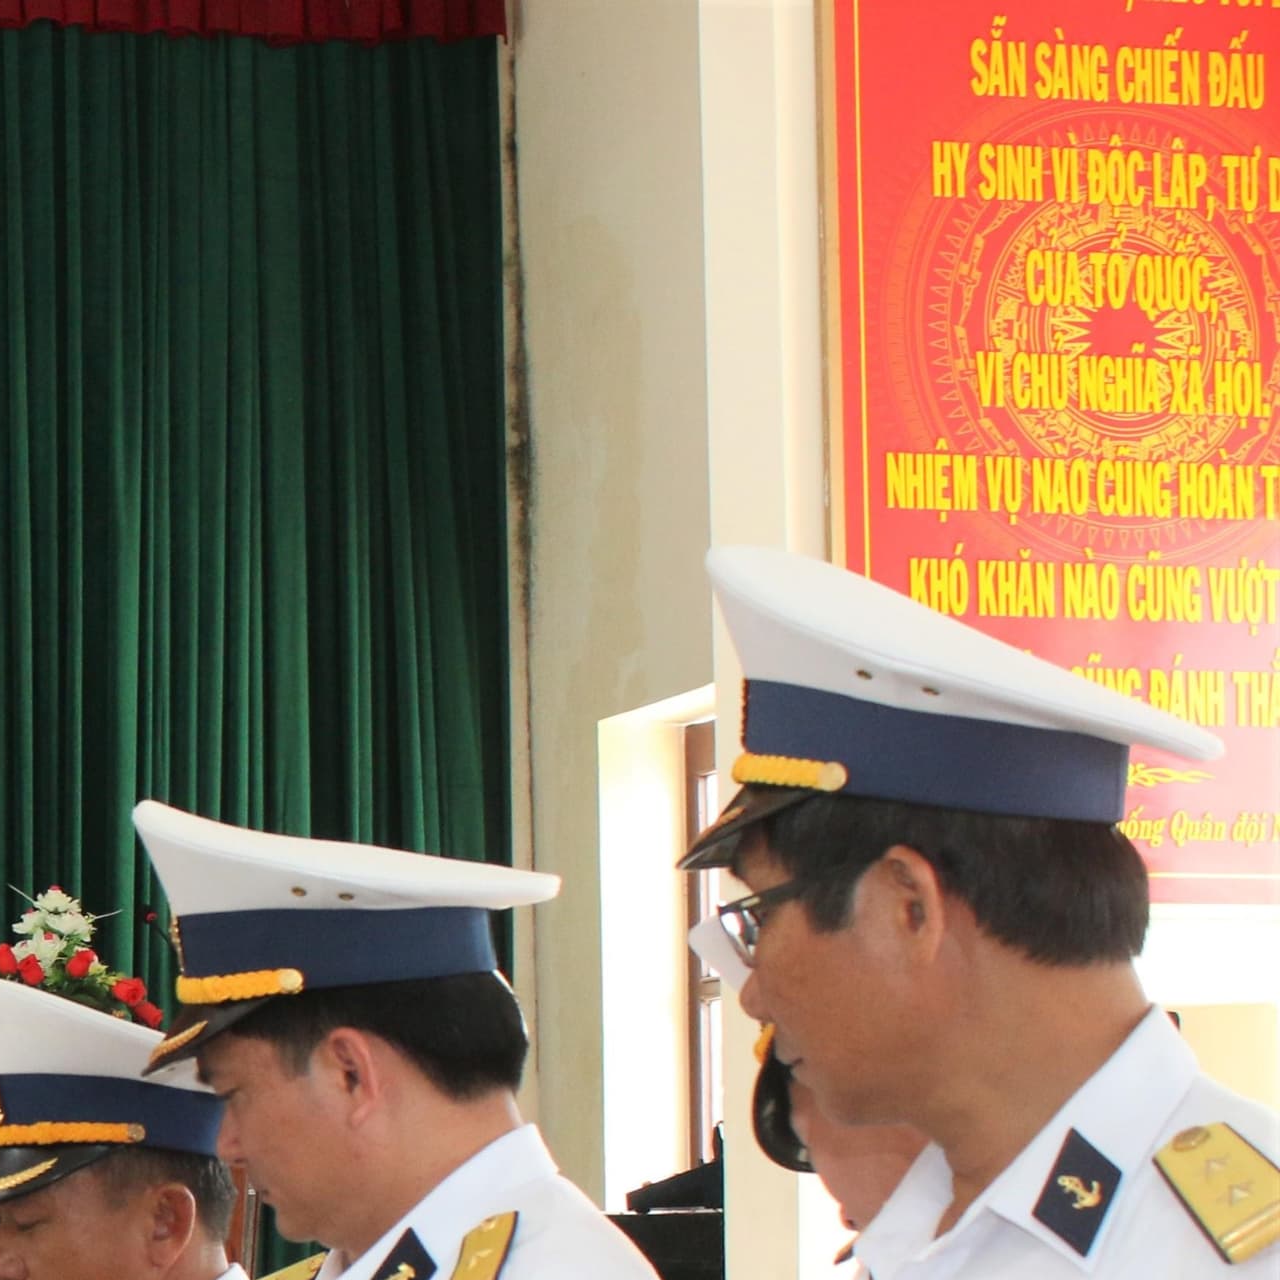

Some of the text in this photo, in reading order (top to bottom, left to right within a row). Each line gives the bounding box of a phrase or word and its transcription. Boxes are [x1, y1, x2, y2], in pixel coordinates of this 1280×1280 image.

[970, 15, 1265, 110] SẴN SÀNG CHIẾN ĐẤU
[932, 141, 970, 198] HY
[979, 143, 1043, 202] SINH
[1051, 132, 1084, 204] VÌ
[1088, 134, 1145, 217] ĐỘC
[1153, 137, 1215, 222] LẬP,
[1221, 145, 1261, 224] TỰ
[1026, 223, 1219, 324] CỦA TỔ QUỐC,
[976, 337, 1004, 407] VÌ
[1013, 331, 1068, 411] CHỦ
[1078, 343, 1161, 414] NGHĨA
[1169, 344, 1204, 416] XÃ
[886, 438, 1280, 525] NHIỆM VỤ NÀO CŨNG HOÀN T
[909, 542, 1280, 636] KHÓ KHĂN NÀO CŨNG VƯỢT
[1150, 654, 1225, 727] ĐÁNH
[1170, 810, 1226, 847] Quân
[1233, 811, 1268, 847] đội
